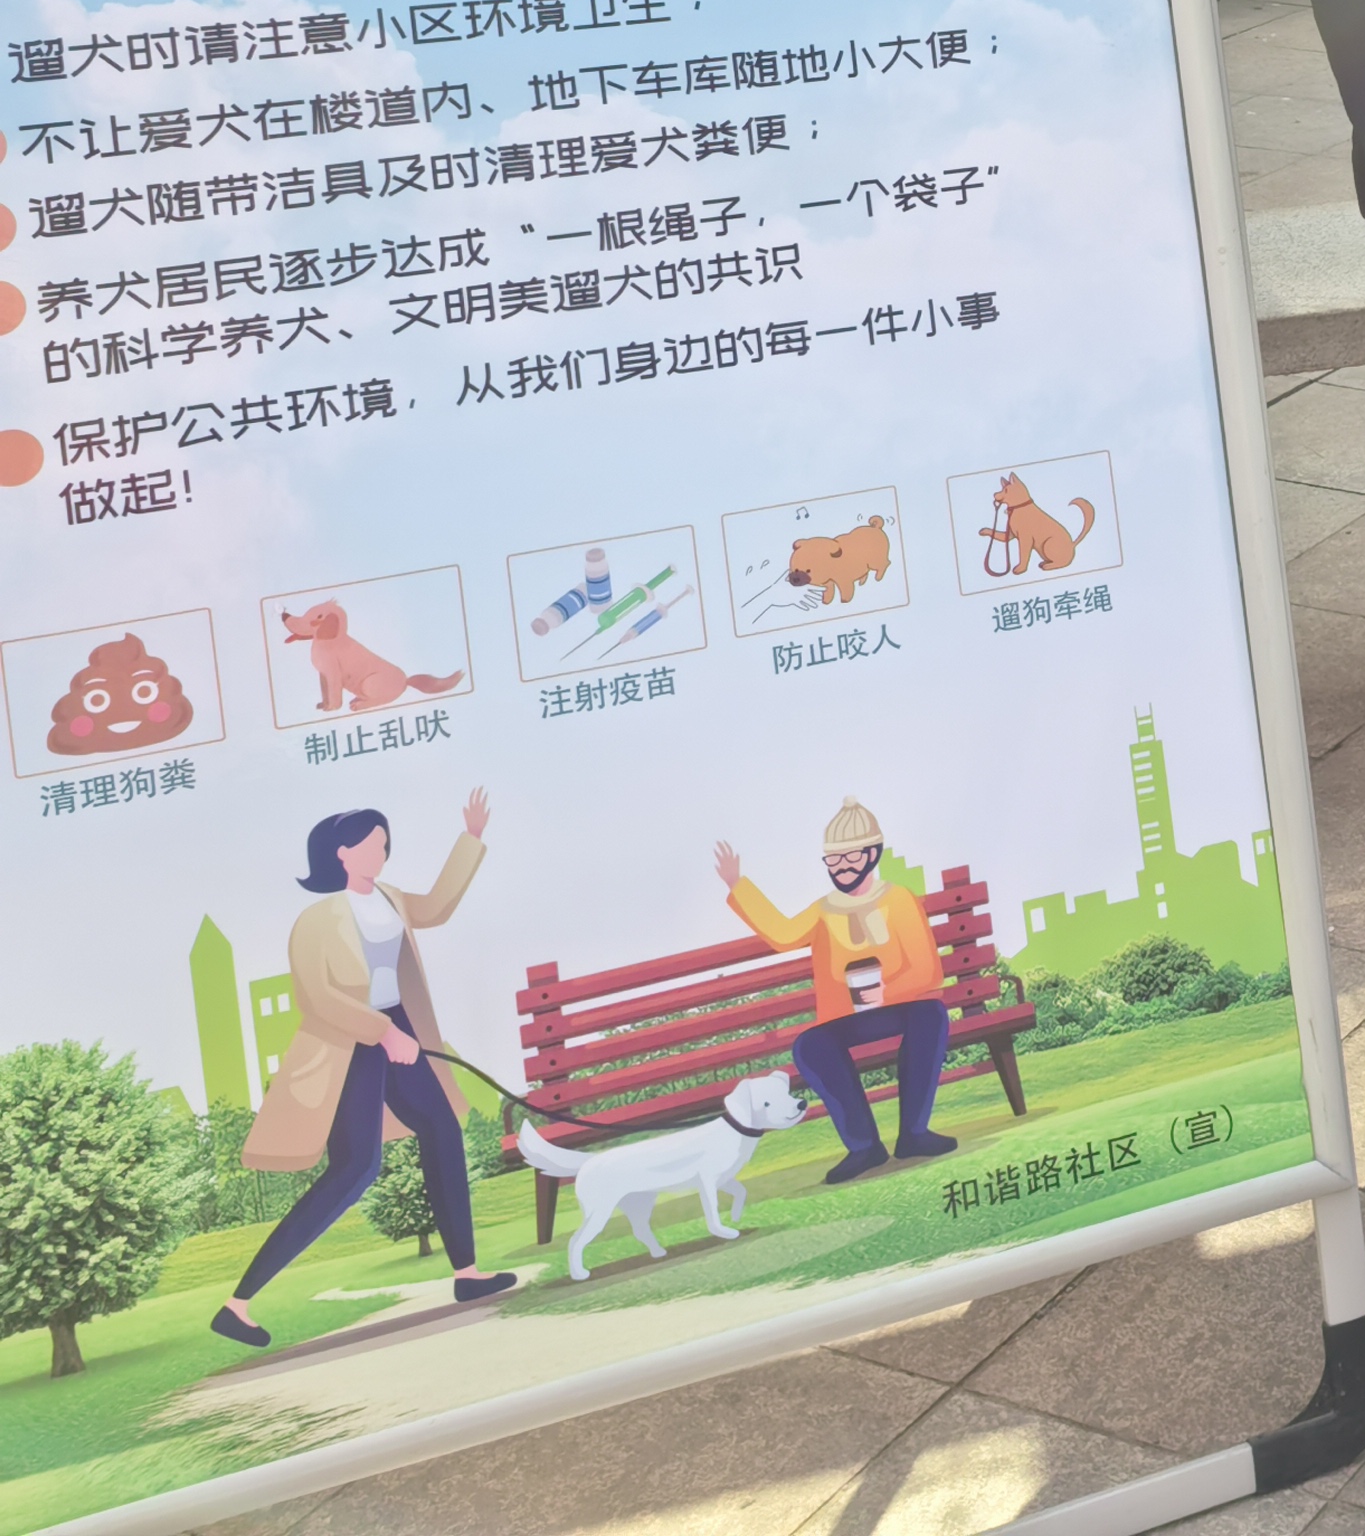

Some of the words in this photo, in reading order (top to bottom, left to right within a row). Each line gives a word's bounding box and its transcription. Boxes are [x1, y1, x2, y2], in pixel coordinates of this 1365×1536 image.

[18, 28, 998, 164] 不让爱犬在楼道内、地下车库随地小大便；
[28, 113, 820, 240] 遛犬随带洁具及时清理爱犬粪便；
[36, 165, 999, 324] 养犬居民逐步达成“一根绳子，一个袋子”
[43, 242, 803, 384] 的科学养犬、文明美遛犬的共识
[52, 291, 1000, 467] 保护公共环境，从我们身边的每一件小事
[58, 469, 193, 526] 做起！
[772, 623, 902, 675] 防止咬人
[991, 582, 1114, 634] 遛狗牵绳
[303, 709, 452, 765] 制止乱吠
[539, 667, 678, 720] 注射疫苗
[39, 756, 197, 818] 清理狗粪
[941, 1103, 1235, 1220] 和谐路社区（宣）
